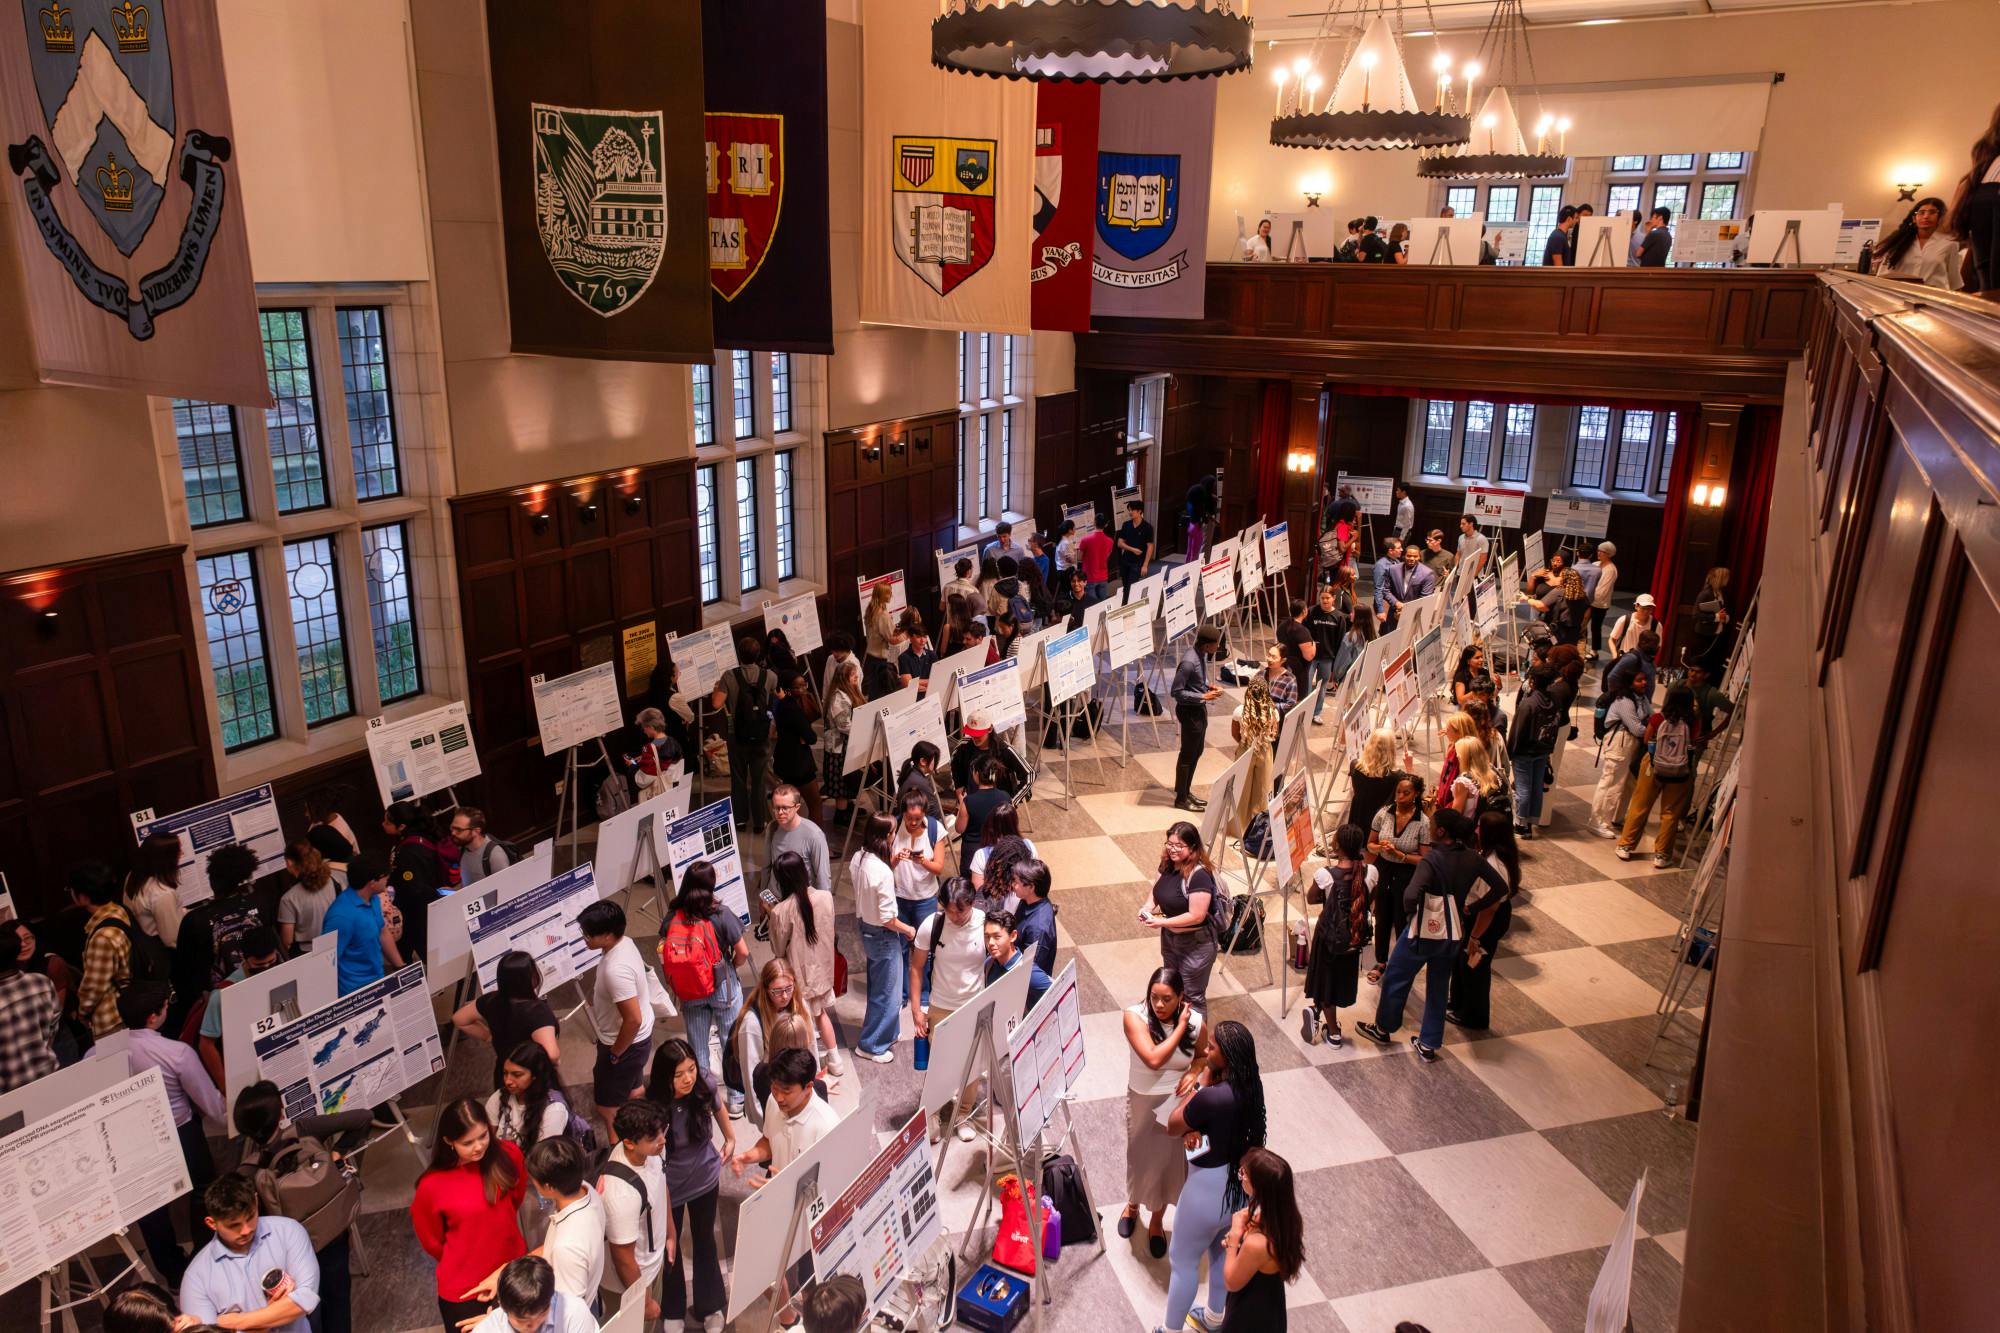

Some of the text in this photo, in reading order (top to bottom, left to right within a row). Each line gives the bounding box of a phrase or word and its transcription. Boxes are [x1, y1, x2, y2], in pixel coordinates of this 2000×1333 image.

[195, 169, 217, 238] LVMEN
[29, 187, 127, 307] IN LVMINE TVO
[1093, 265, 1177, 285] LUX ET VERITAS
[576, 279, 628, 306] 1769
[881, 707, 890, 717] 55
[370, 718, 382, 729] 82
[135, 812, 151, 823] 81
[665, 809, 676, 821] 54
[467, 901, 481, 915] 53
[256, 1016, 276, 1034] 52
[1007, 1015, 1016, 1034] 26
[16, 1134, 40, 1149] CRISPR
[63, 1112, 87, 1127] systems
[36, 1124, 50, 1134] DNA
[50, 1111, 77, 1128] sequence
[810, 1197, 825, 1221] 25
